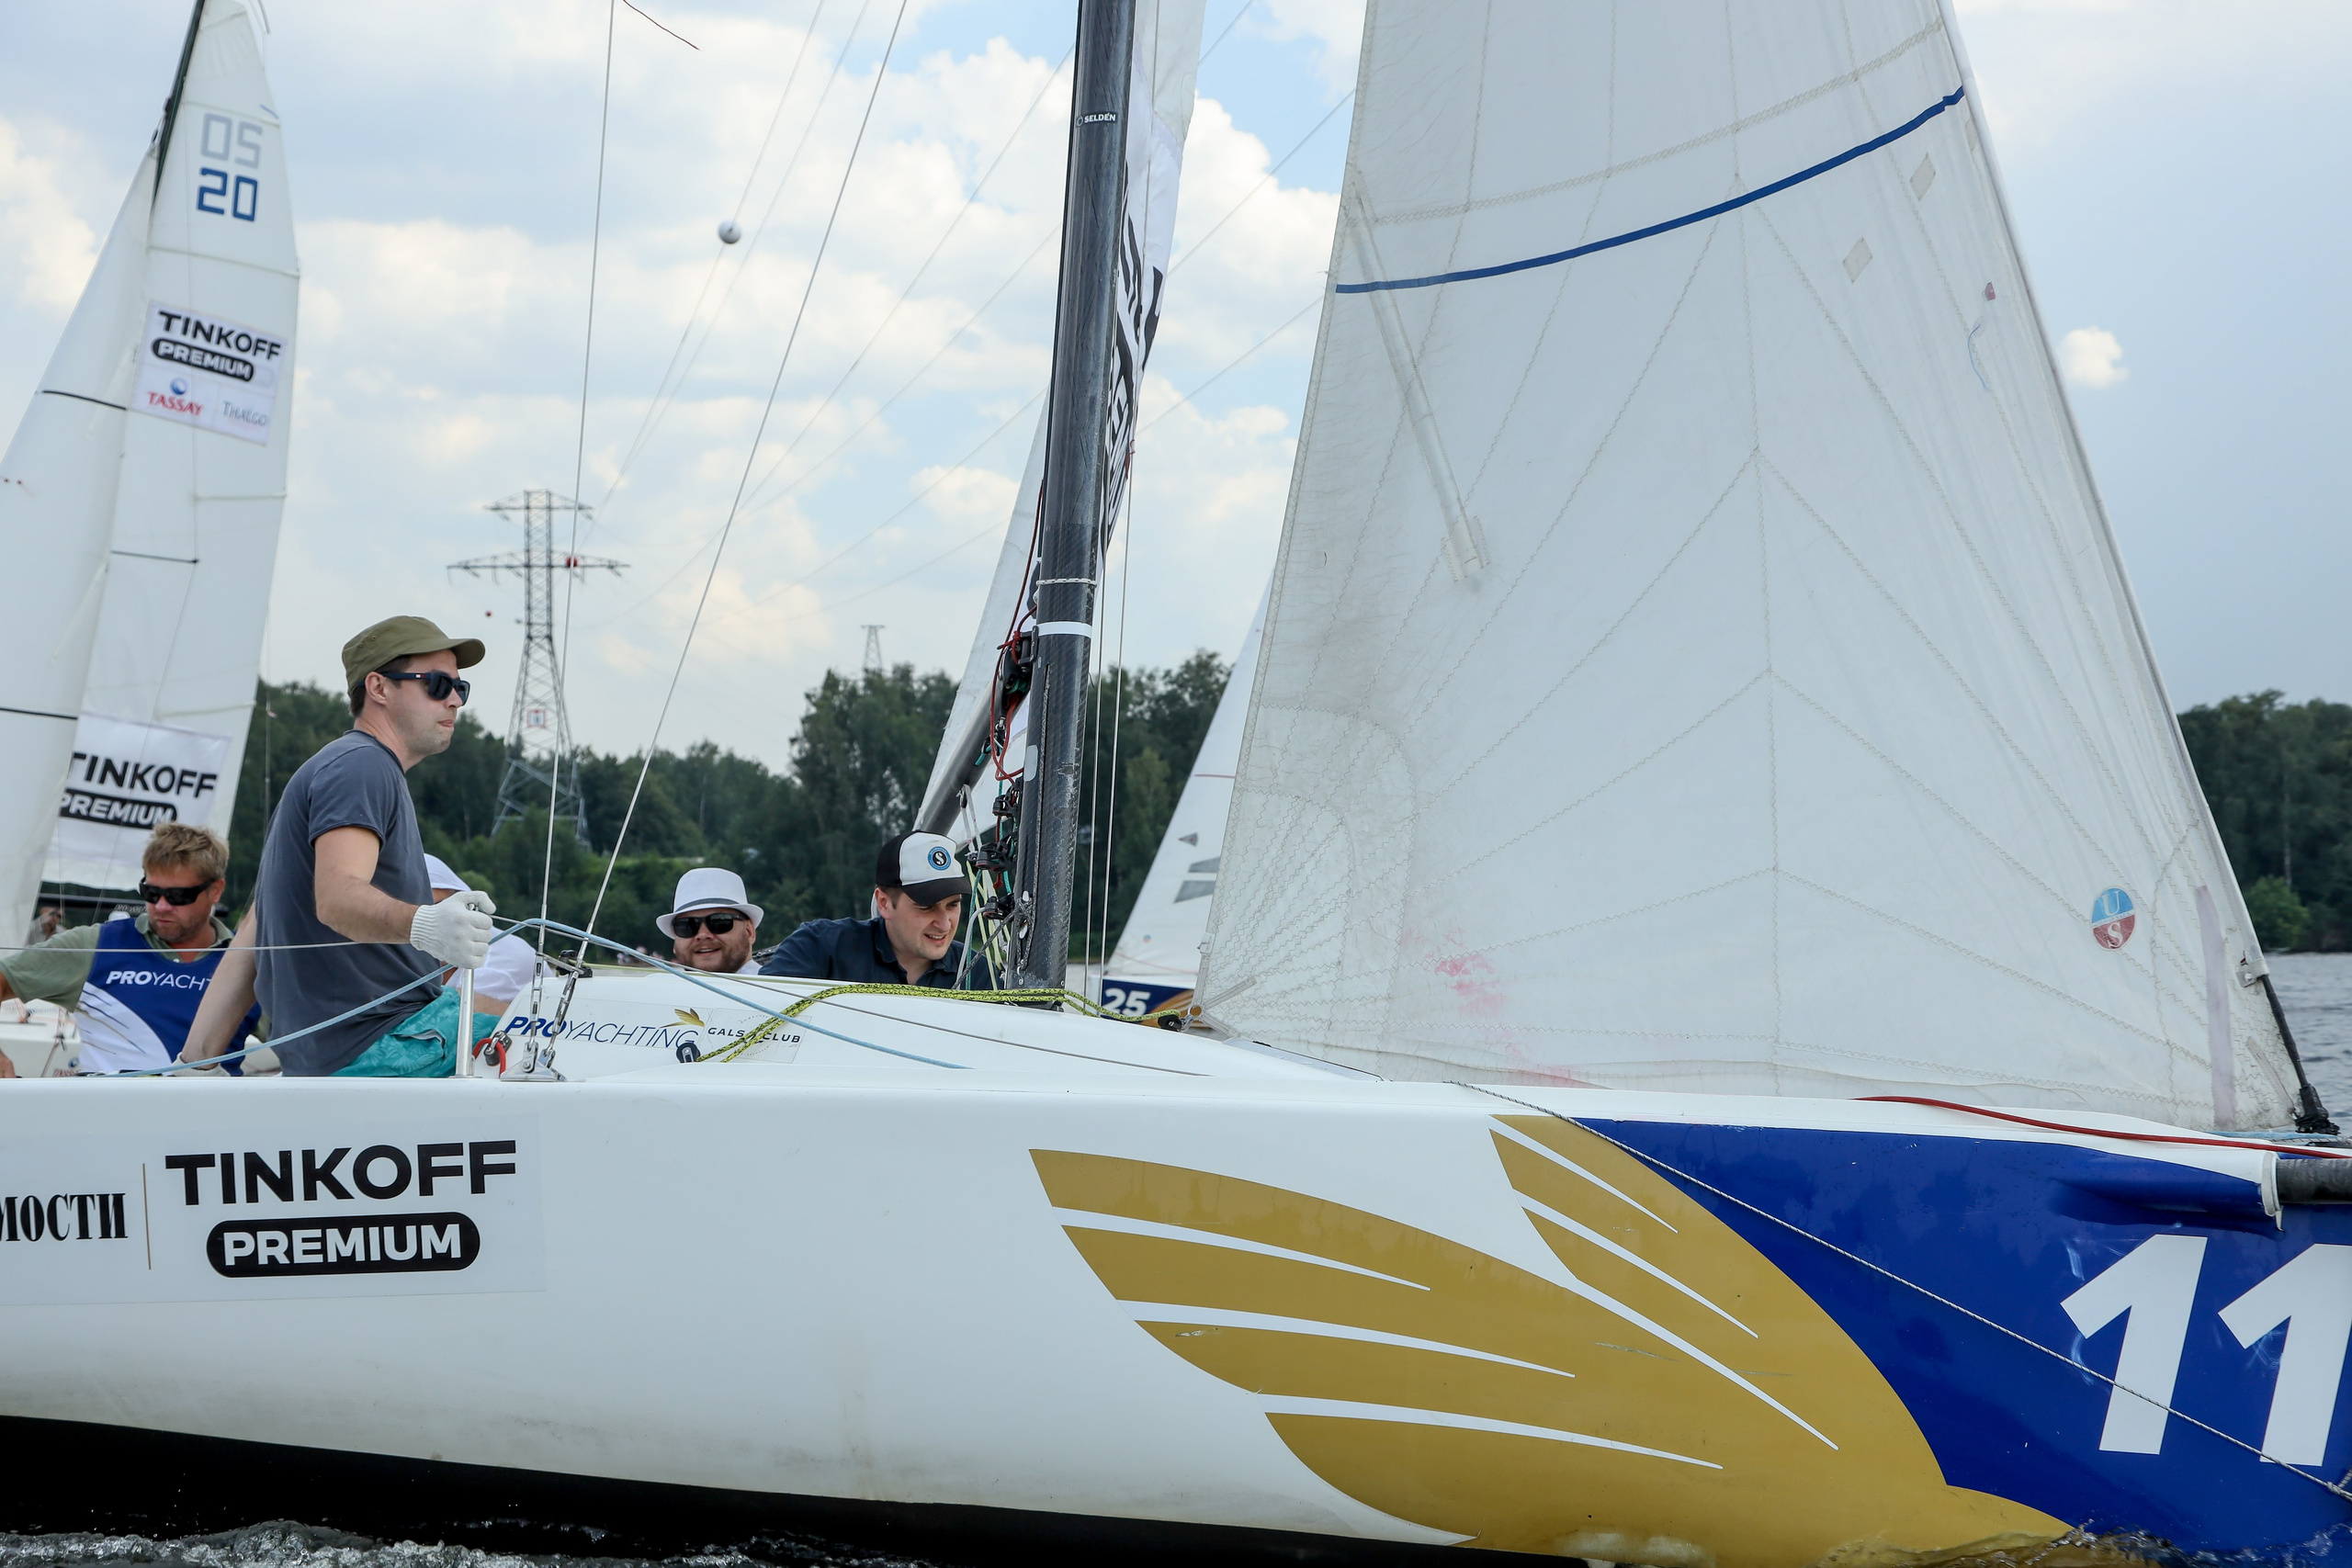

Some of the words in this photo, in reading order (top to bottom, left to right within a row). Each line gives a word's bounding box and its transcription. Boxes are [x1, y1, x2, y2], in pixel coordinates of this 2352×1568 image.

[197, 167, 258, 221] 20
[158, 310, 281, 360] TINKOFF
[157, 341, 251, 378] PREMIUM
[148, 390, 204, 416] TASSAY
[1102, 987, 1151, 1018] 25
[505, 1016, 699, 1049] PROYACHTING
[707, 1027, 745, 1039] GALS
[762, 1032, 801, 1043] CLUB
[164, 1140, 516, 1206] TINKOFF
[222, 1223, 462, 1267] PREMIUM
[2060, 1234, 2352, 1467] 11
